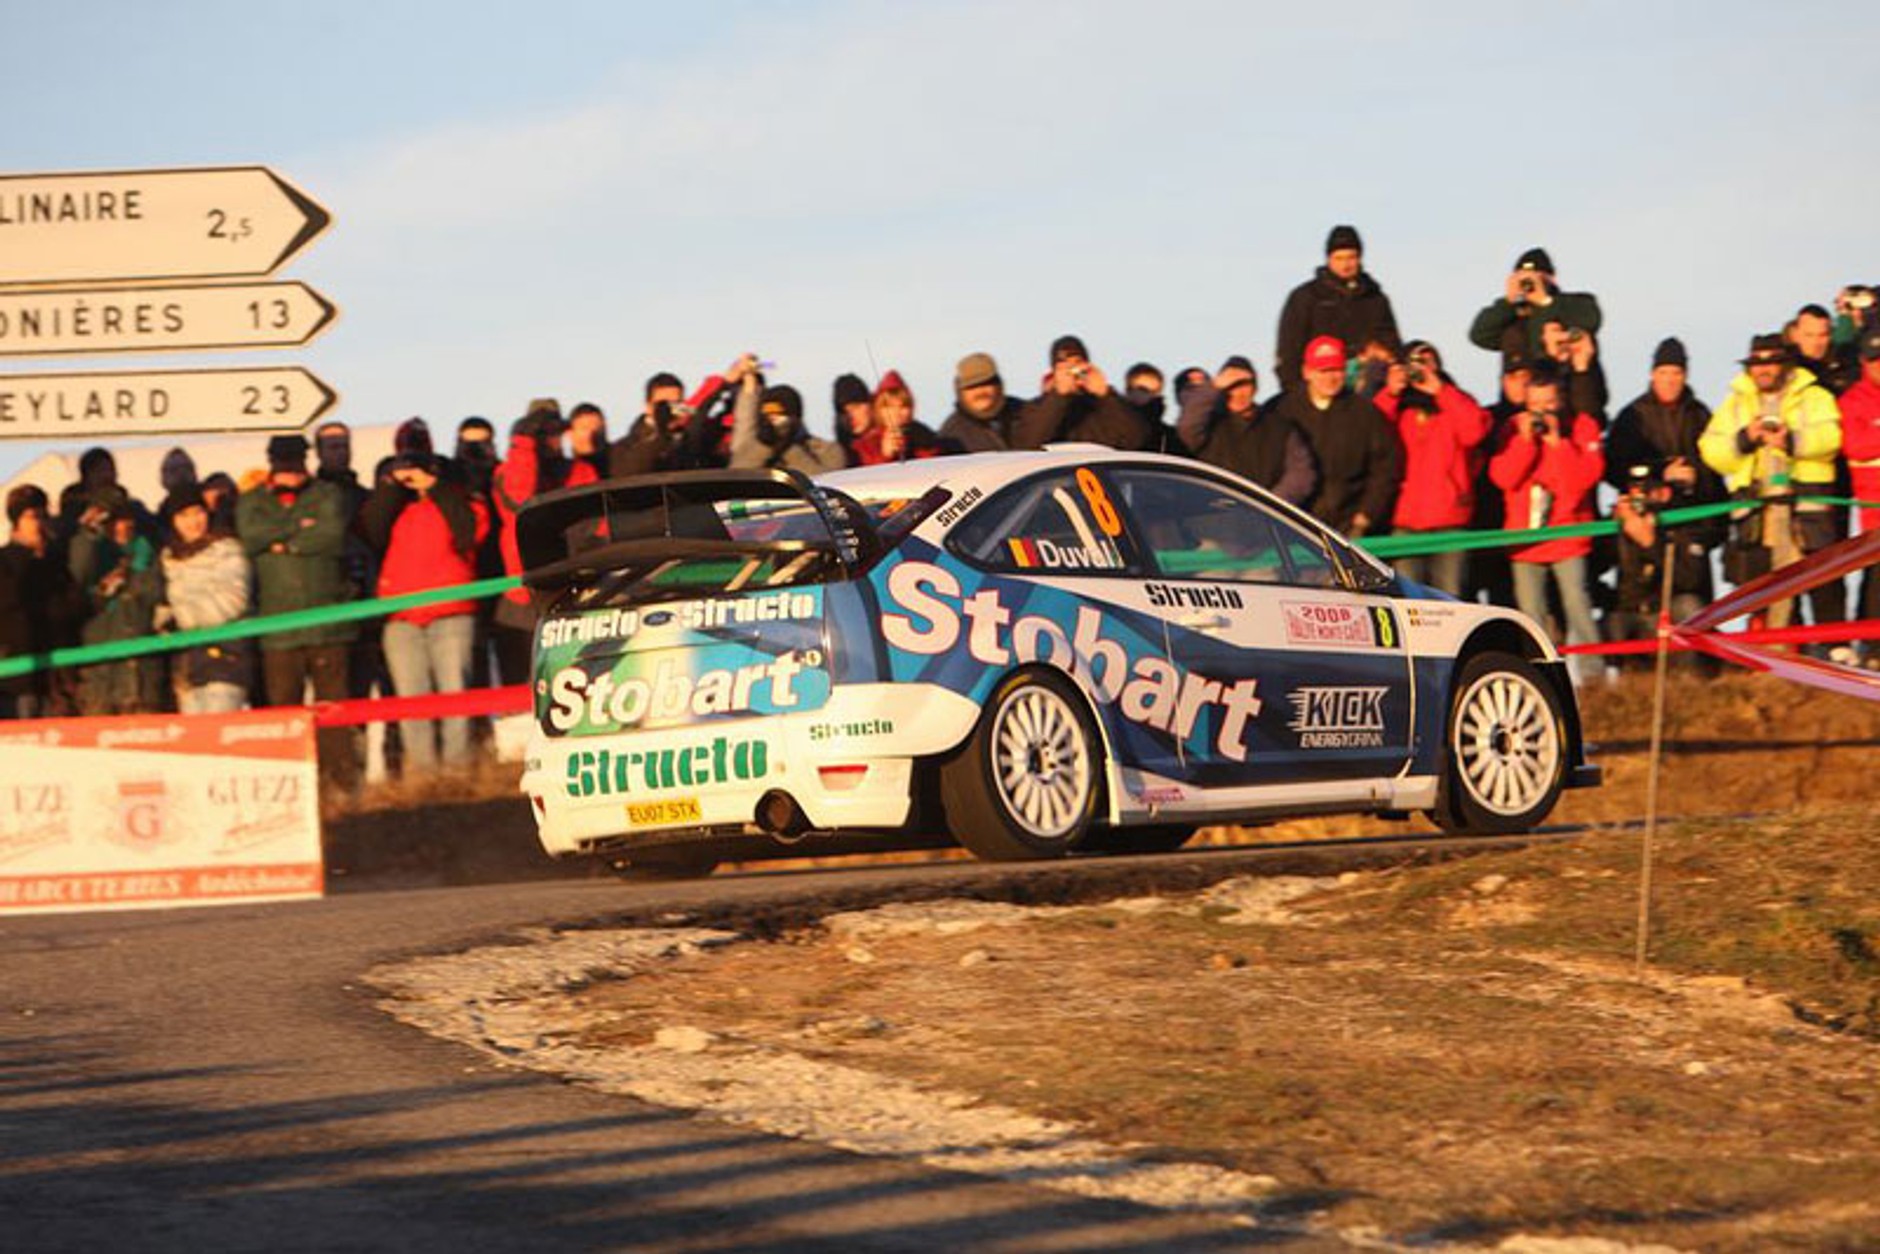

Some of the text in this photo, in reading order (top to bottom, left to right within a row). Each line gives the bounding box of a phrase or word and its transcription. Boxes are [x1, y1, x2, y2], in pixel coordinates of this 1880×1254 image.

[249, 300, 290, 330] 13
[241, 386, 290, 415] 23
[1075, 466, 1122, 537] 8
[1036, 540, 1116, 568] Duval
[683, 592, 815, 629] Structo
[1144, 583, 1244, 610] Structo
[541, 609, 638, 648] Structo
[1300, 605, 1351, 623] 2008
[1375, 606, 1394, 647] 8
[880, 561, 1261, 762] Stobart
[550, 650, 803, 730] Stobart
[809, 718, 894, 741] Structo
[566, 737, 768, 797] Structo
[628, 801, 699, 823] EU07 STX
